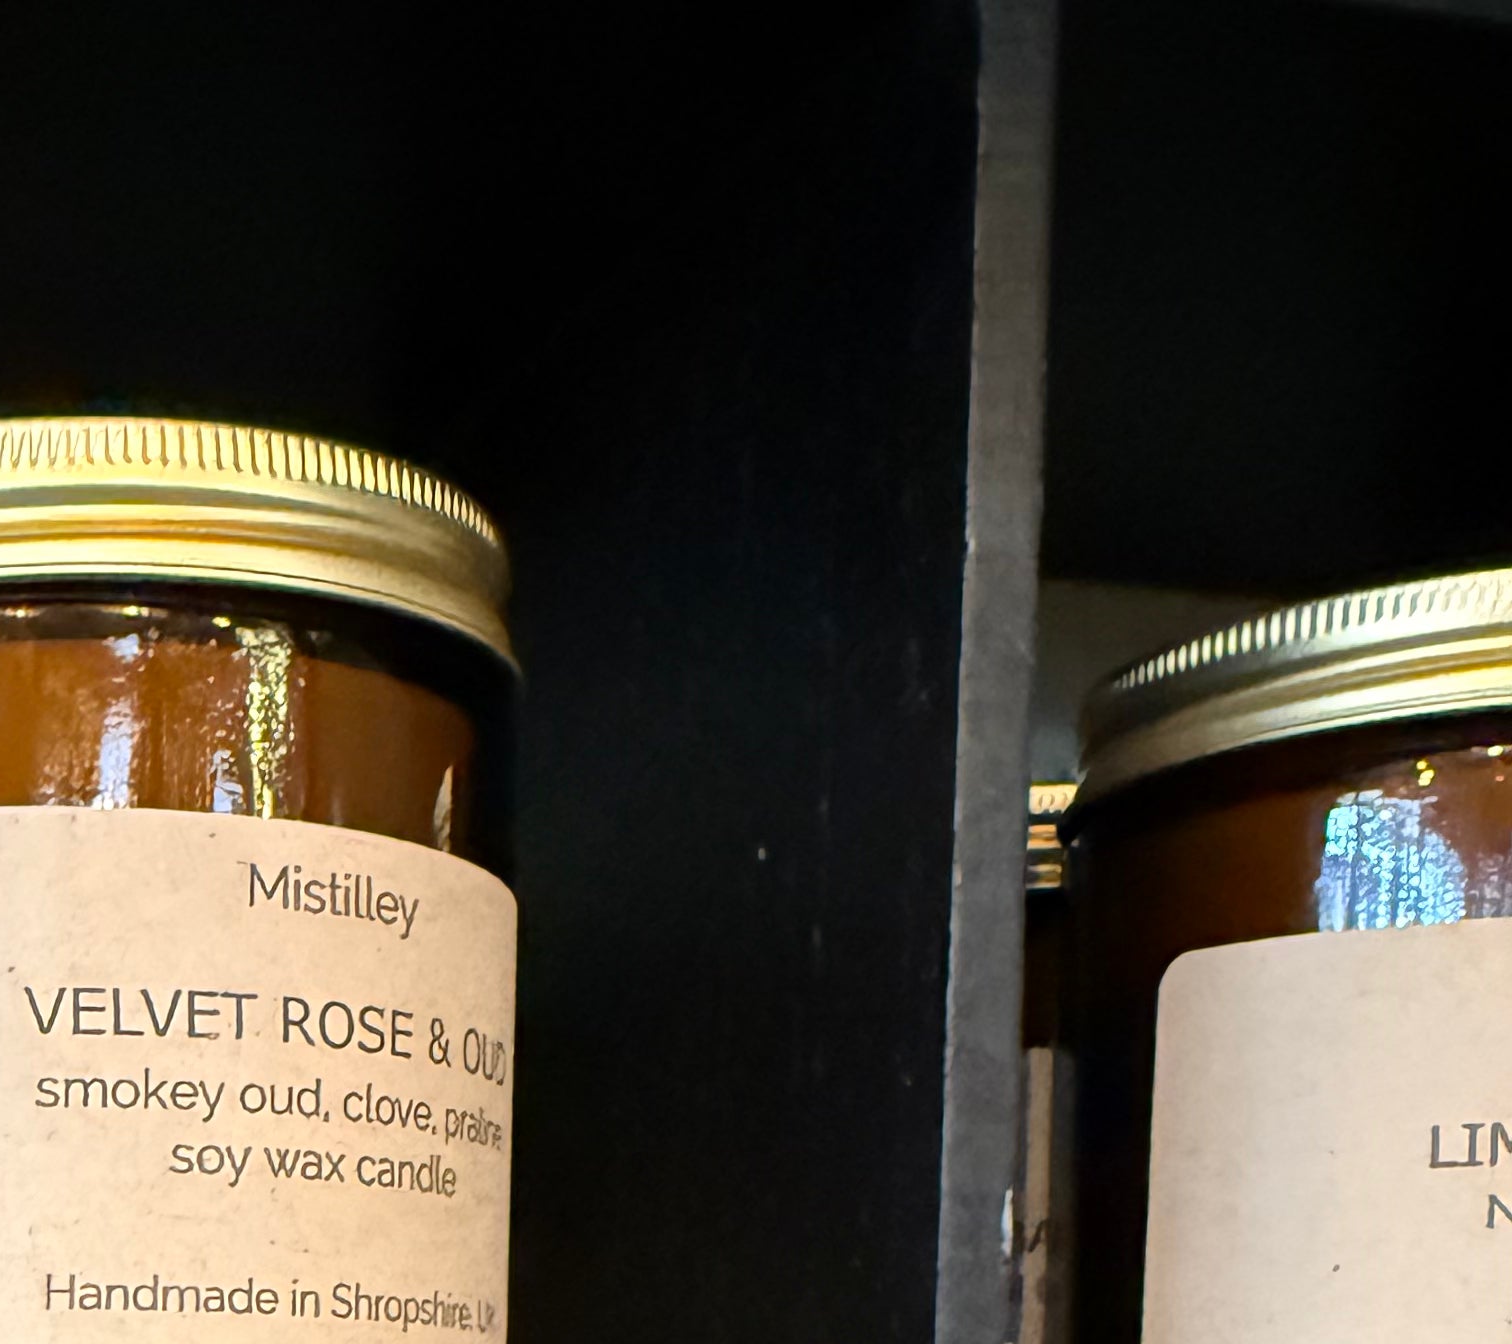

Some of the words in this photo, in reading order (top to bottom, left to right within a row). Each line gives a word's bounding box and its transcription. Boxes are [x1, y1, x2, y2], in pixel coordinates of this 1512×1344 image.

[248, 863, 420, 939] Mistilley
[24, 986, 258, 1040] VELVET
[282, 996, 414, 1059] ROSE
[428, 1017, 451, 1069] &
[34, 1068, 226, 1122] smokey
[169, 1142, 252, 1187] soy
[263, 1146, 346, 1183] wax
[356, 1154, 457, 1198] candle
[45, 1273, 279, 1317] Handmade
[290, 1278, 320, 1317] in
